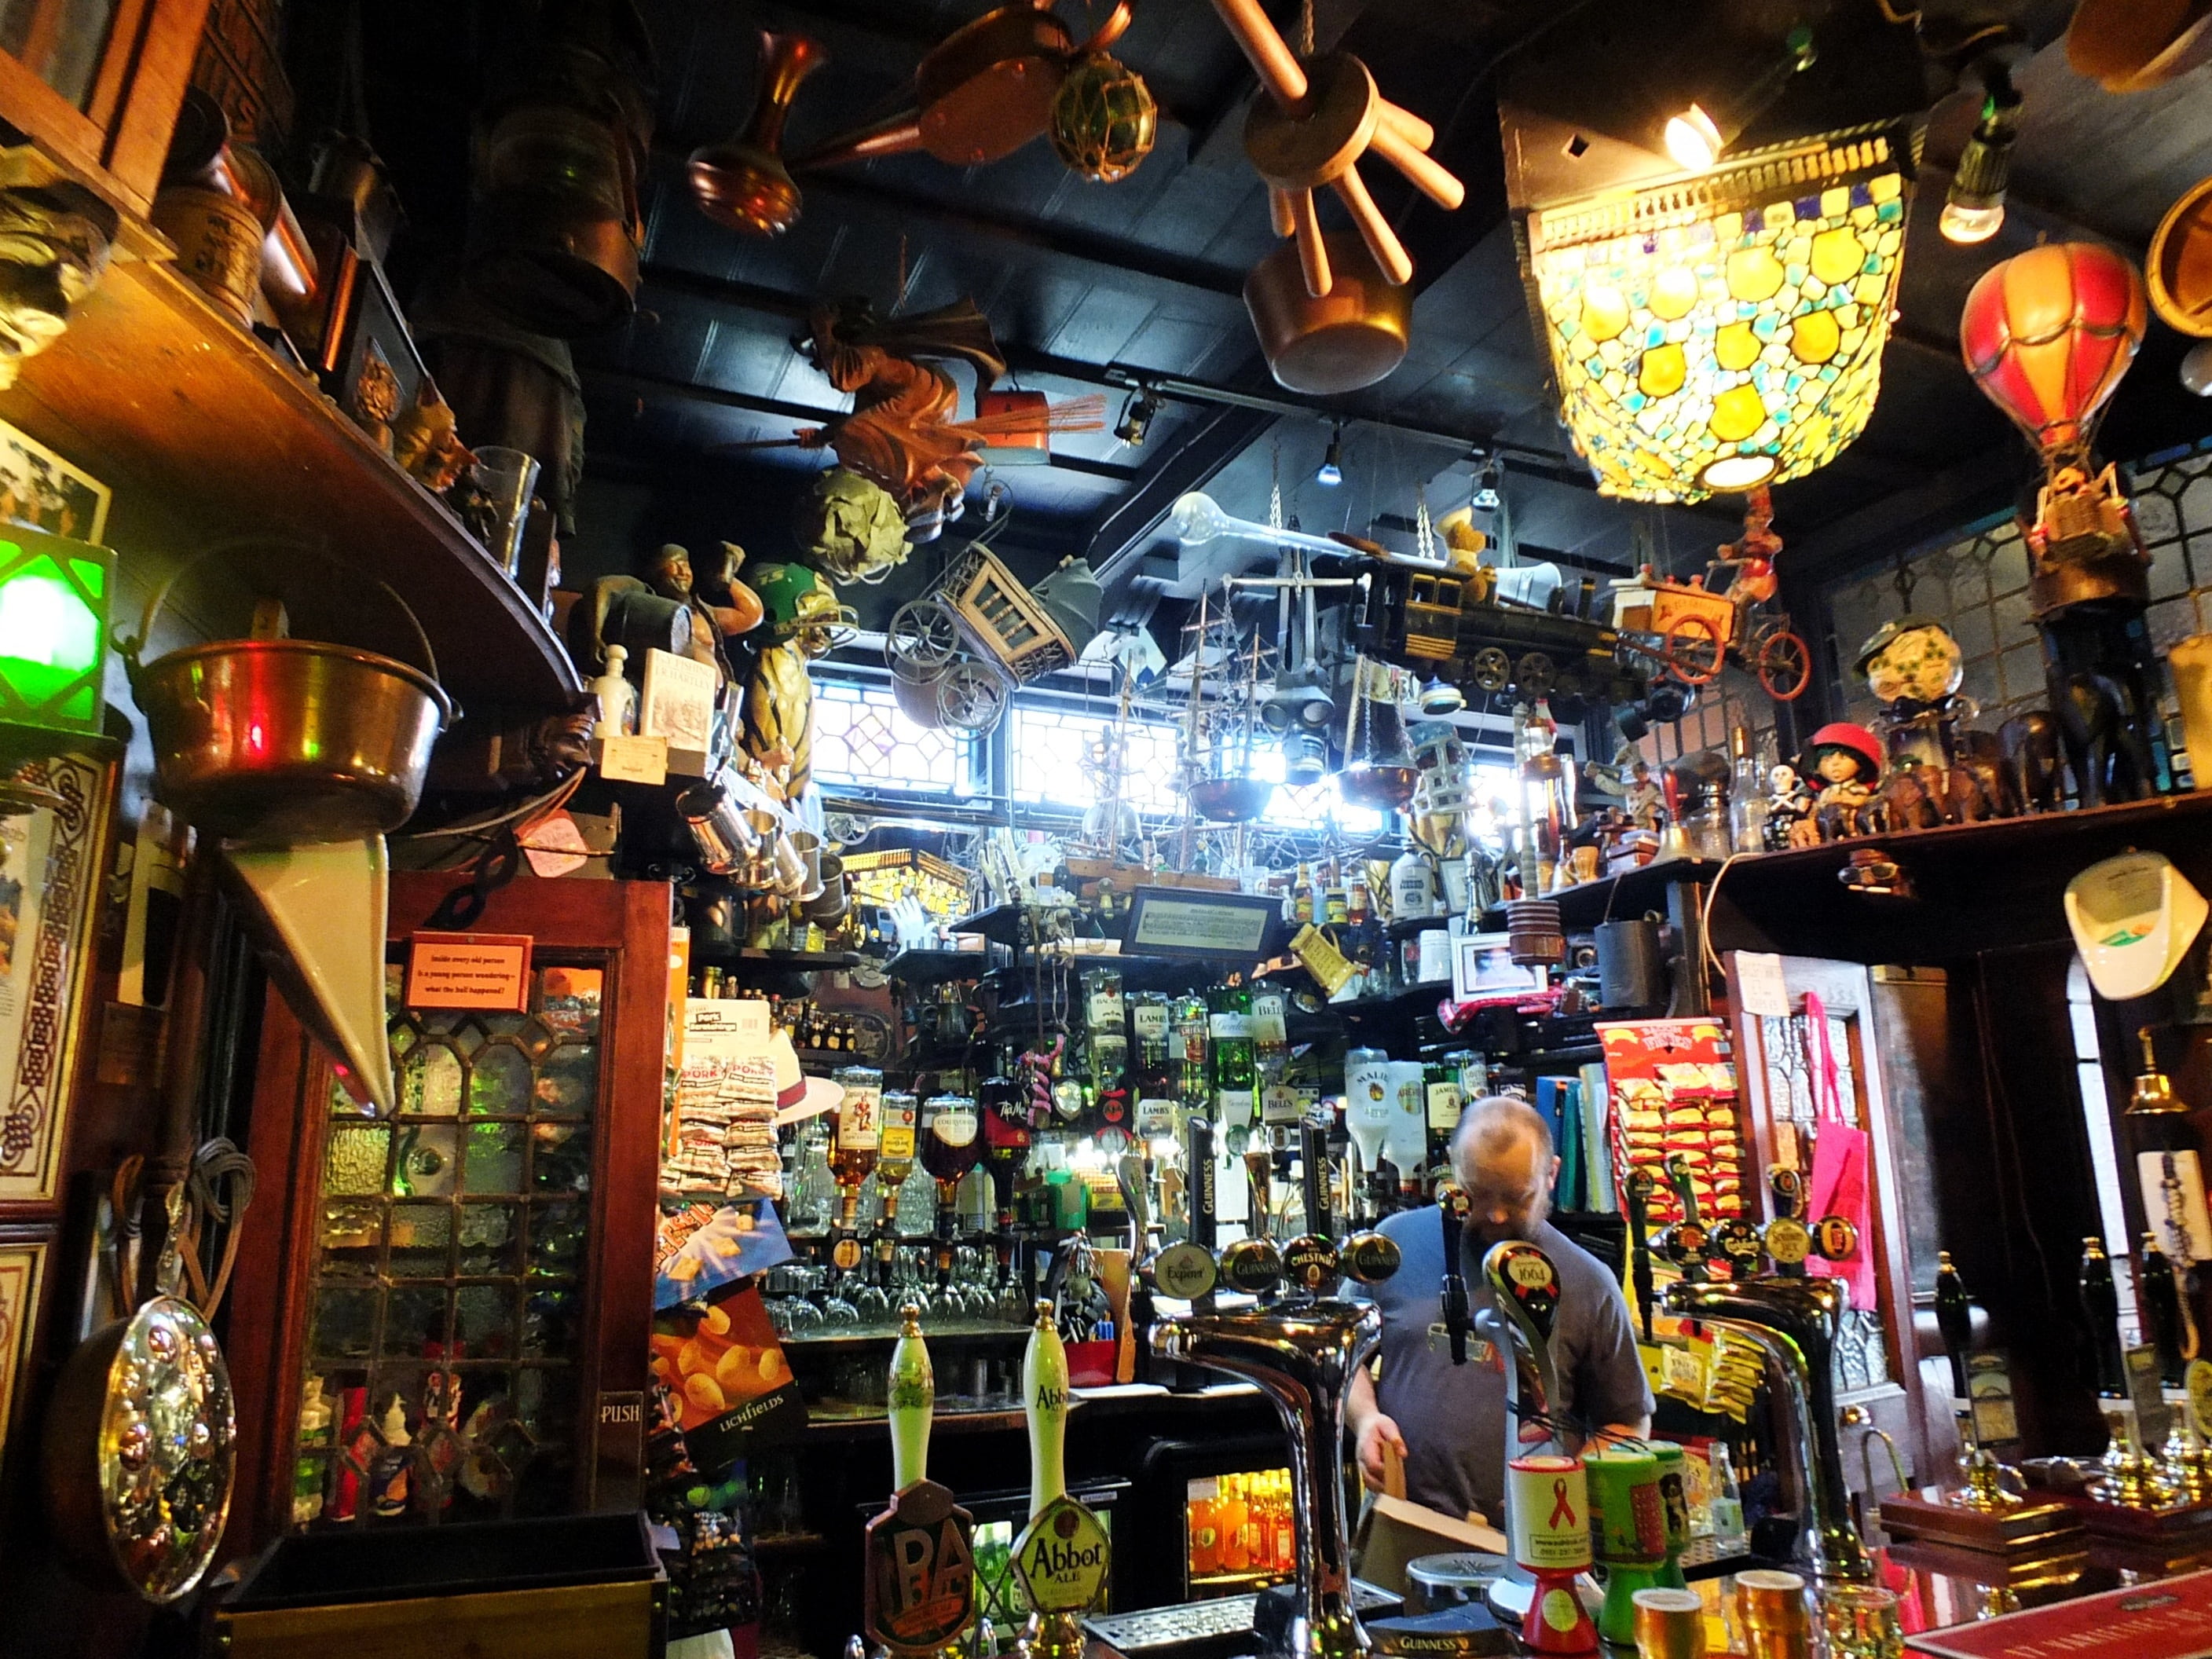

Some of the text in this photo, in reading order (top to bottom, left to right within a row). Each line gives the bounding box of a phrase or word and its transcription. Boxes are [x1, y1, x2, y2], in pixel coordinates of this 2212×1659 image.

[1203, 1159, 1214, 1214] GUINNESS
[1319, 1156, 1331, 1210] GUINNESS
[1236, 1261, 1279, 1276] GUINNESS
[1291, 1252, 1335, 1270] CHESTNUT
[1166, 1265, 1204, 1280] Export
[601, 1404, 640, 1423] PUSH
[1029, 1537, 1103, 1580] Abbot
[1054, 1572, 1081, 1584] ALE
[1400, 1635, 1456, 1650] GUINNESS
